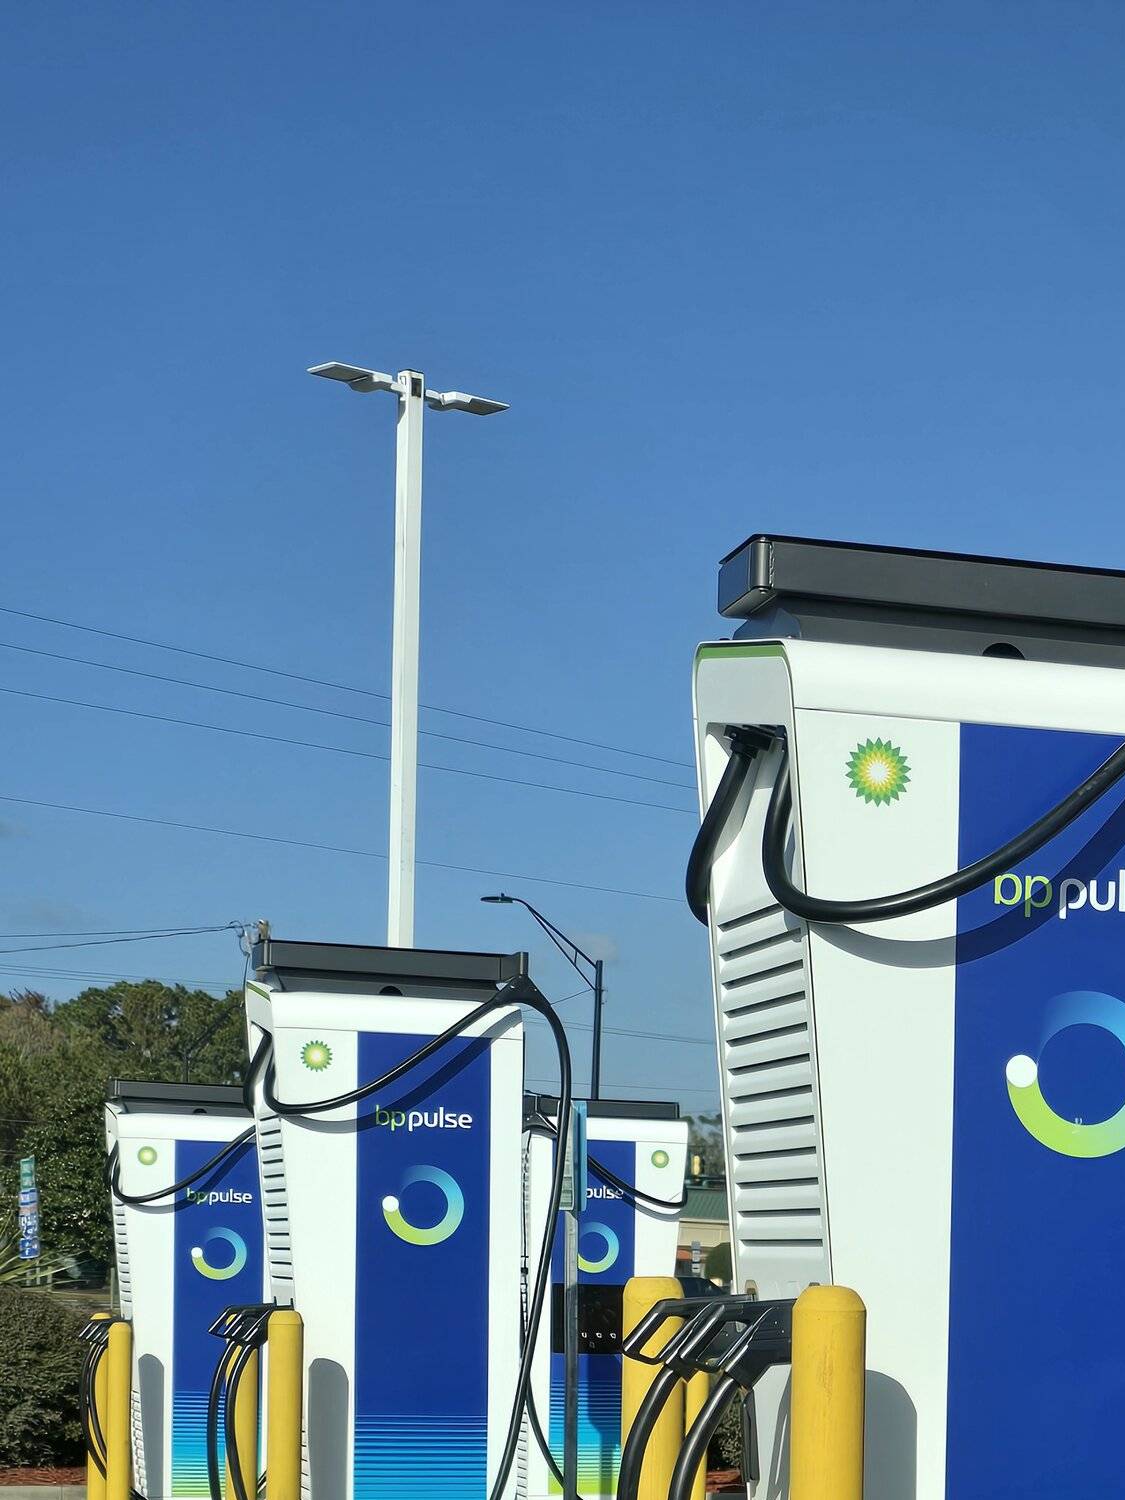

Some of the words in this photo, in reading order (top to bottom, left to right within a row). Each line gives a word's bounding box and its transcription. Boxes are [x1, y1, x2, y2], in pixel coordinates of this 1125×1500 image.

[994, 873, 1053, 918] bp
[376, 1104, 406, 1131] bp
[408, 1106, 473, 1131] pulse
[187, 1188, 208, 1205] bp
[209, 1188, 253, 1205] pulse
